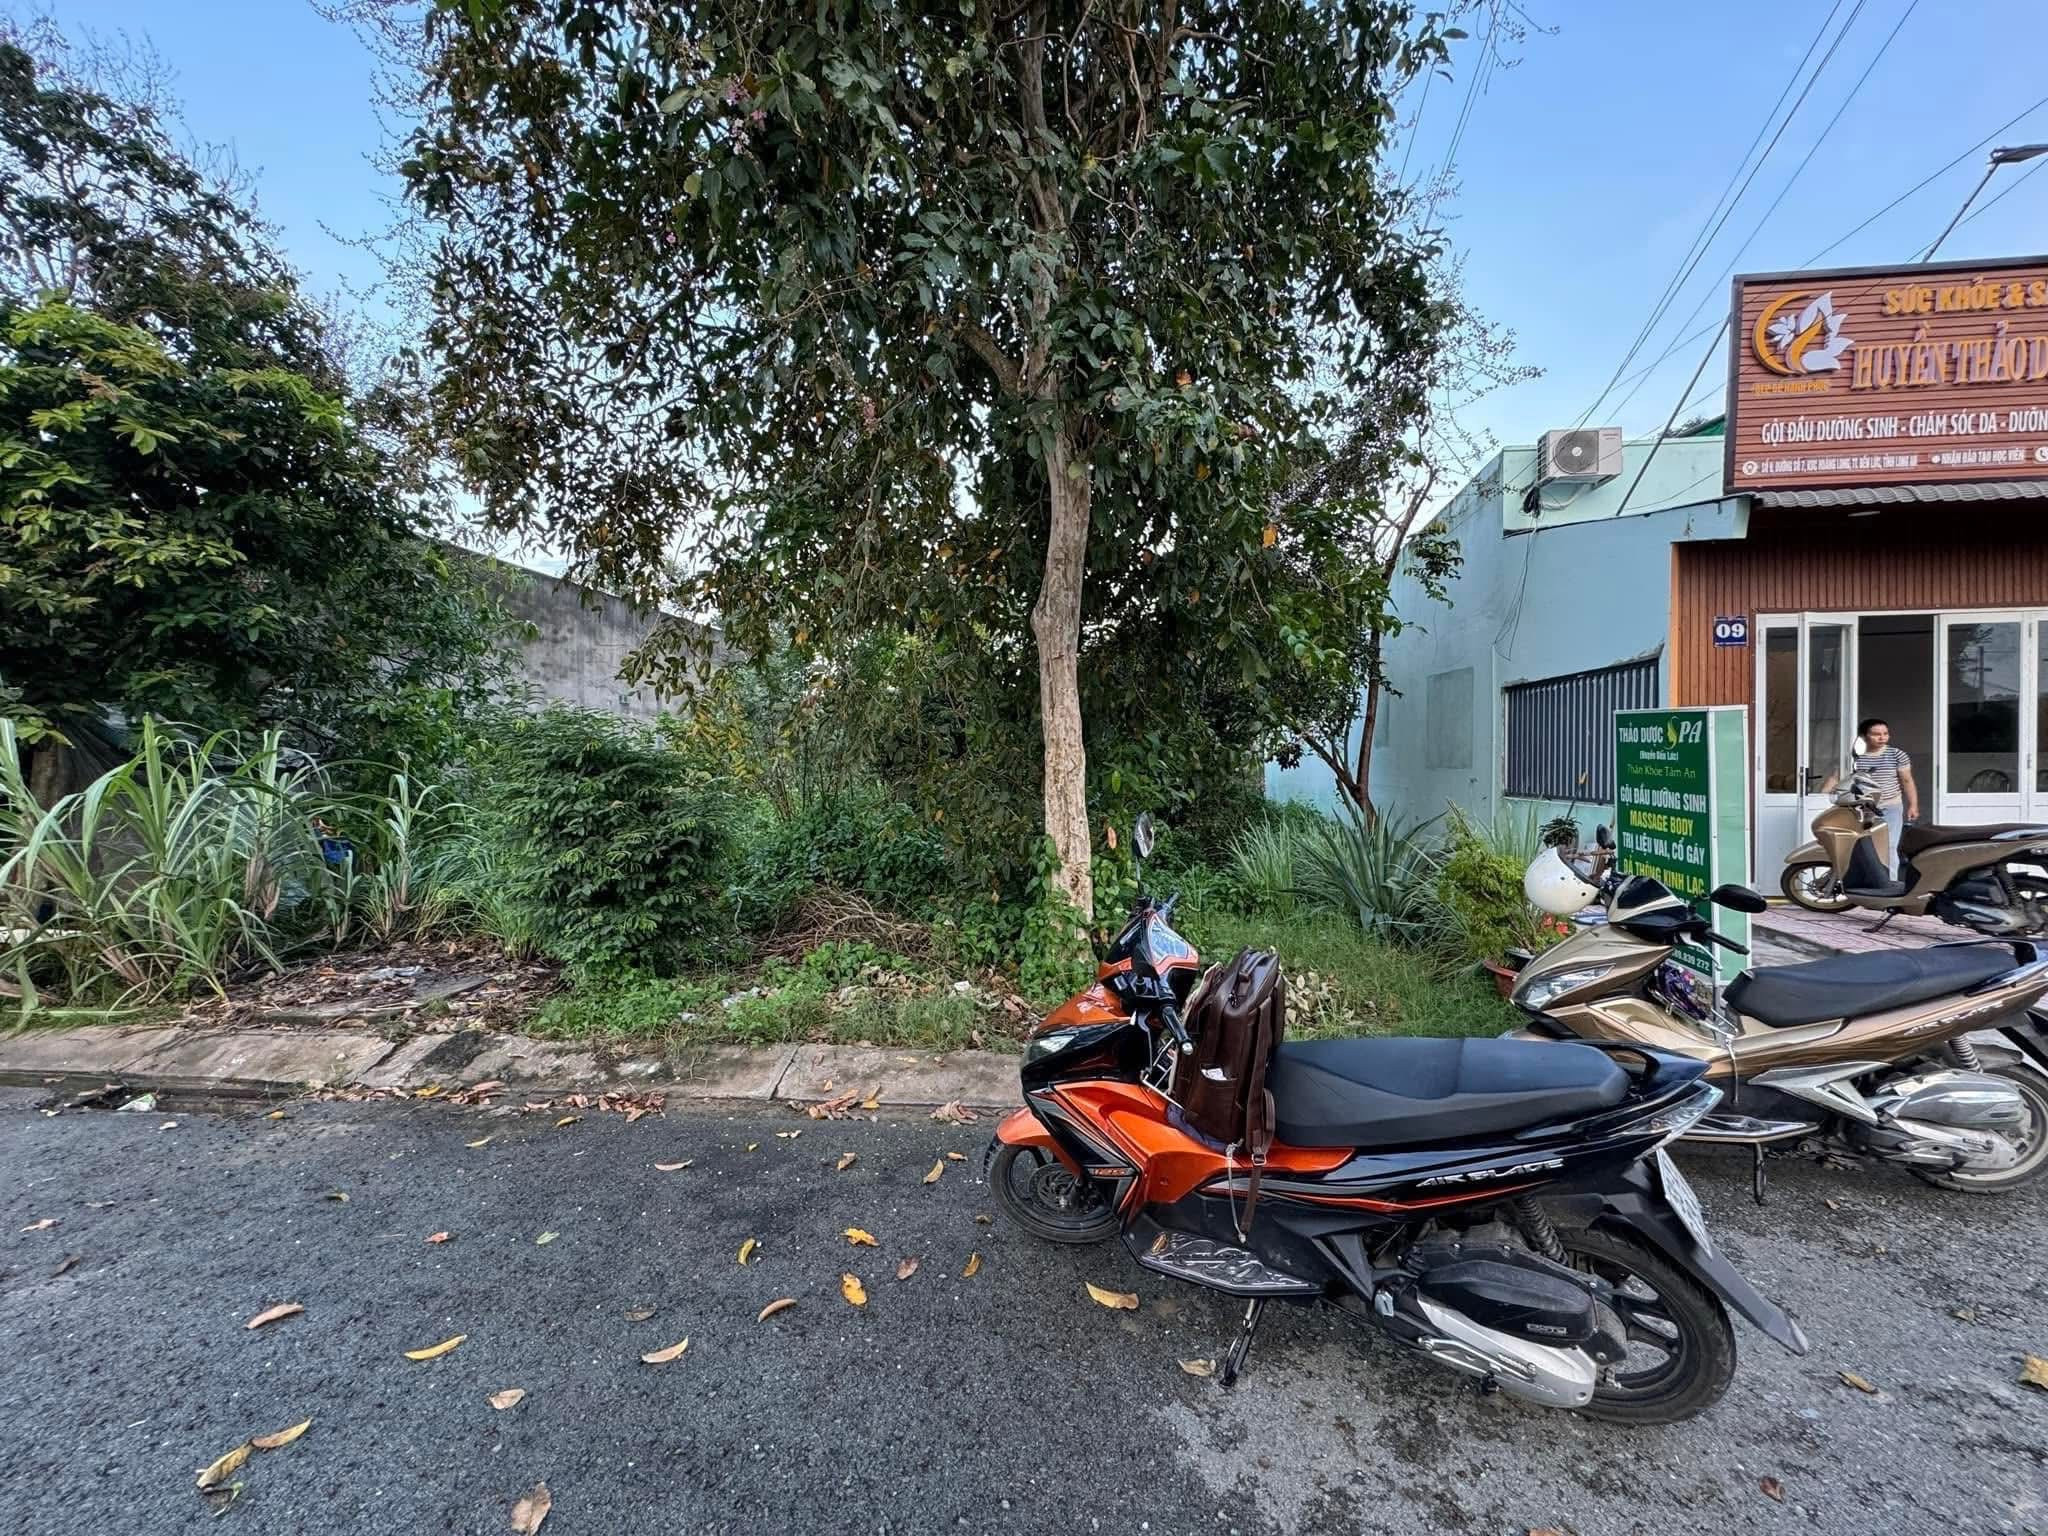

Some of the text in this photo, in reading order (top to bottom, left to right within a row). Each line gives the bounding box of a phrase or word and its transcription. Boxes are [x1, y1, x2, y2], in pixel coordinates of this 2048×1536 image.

[2002, 283, 2024, 310] &
[1951, 320, 2026, 384] THẢO
[1761, 417, 1785, 447] GỘI
[1816, 415, 1864, 441] DƯỠNG
[1866, 416, 1898, 439] SINH
[1909, 409, 1947, 437] CHĂM
[1950, 407, 1977, 435] SÓC
[1979, 411, 1998, 433] DA
[1716, 623, 1745, 638] 09
[1619, 720, 1639, 743] THẢO
[1640, 725, 1664, 746] DƯỢC
[1620, 784, 1632, 806] GỘI
[1651, 786, 1680, 810] DƯỠNG
[1683, 792, 1706, 814] SINH
[1630, 809, 1694, 837] MASSAGE BODY
[1622, 831, 1634, 853] TRỊ
[1635, 832, 1652, 856] LIỆU
[1663, 868, 1685, 892] KINH
